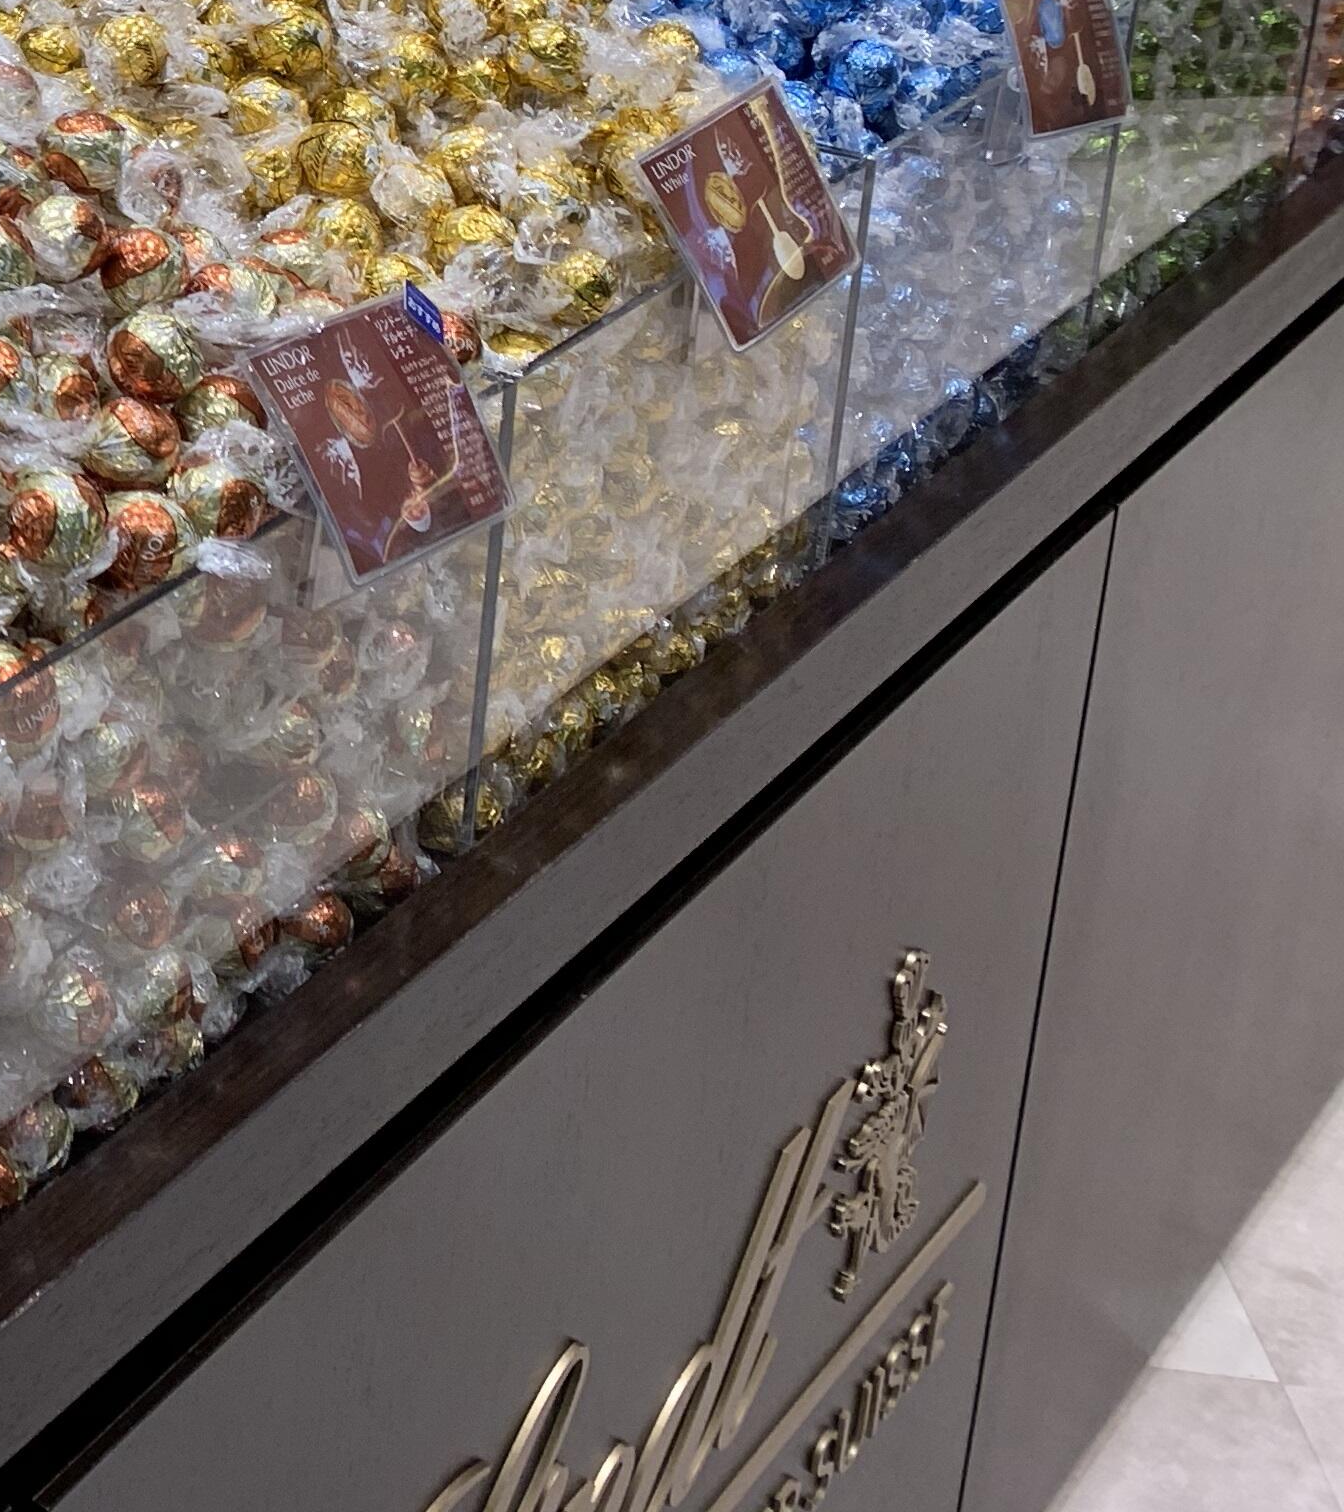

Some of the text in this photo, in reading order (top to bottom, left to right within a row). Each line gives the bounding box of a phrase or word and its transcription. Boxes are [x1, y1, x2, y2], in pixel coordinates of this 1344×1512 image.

[650, 143, 697, 180] LINDOR
[660, 170, 690, 195] White
[260, 344, 317, 378] LINDOR
[272, 367, 322, 395] Dulce de
[281, 389, 317, 410] Leche
